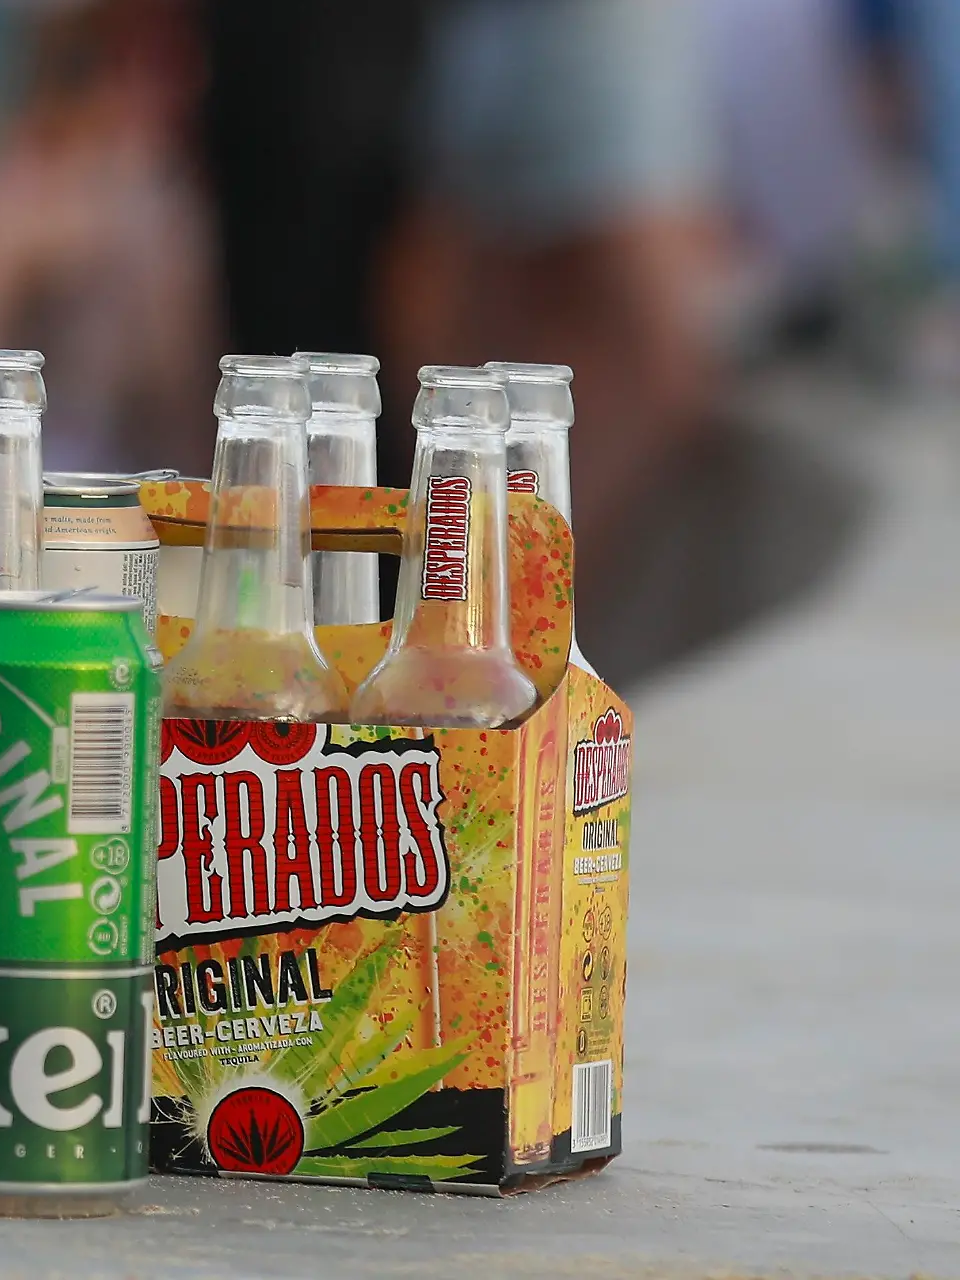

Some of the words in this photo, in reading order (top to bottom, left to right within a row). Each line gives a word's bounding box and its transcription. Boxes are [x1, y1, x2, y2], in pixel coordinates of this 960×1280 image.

[425, 477, 469, 598] DESPERADOS
[582, 818, 620, 852] ORIGINAL
[163, 1048, 208, 1062] FLAVOURED
[238, 1039, 294, 1054] AROMATIZADA
[219, 1055, 260, 1066] TEQUILA
